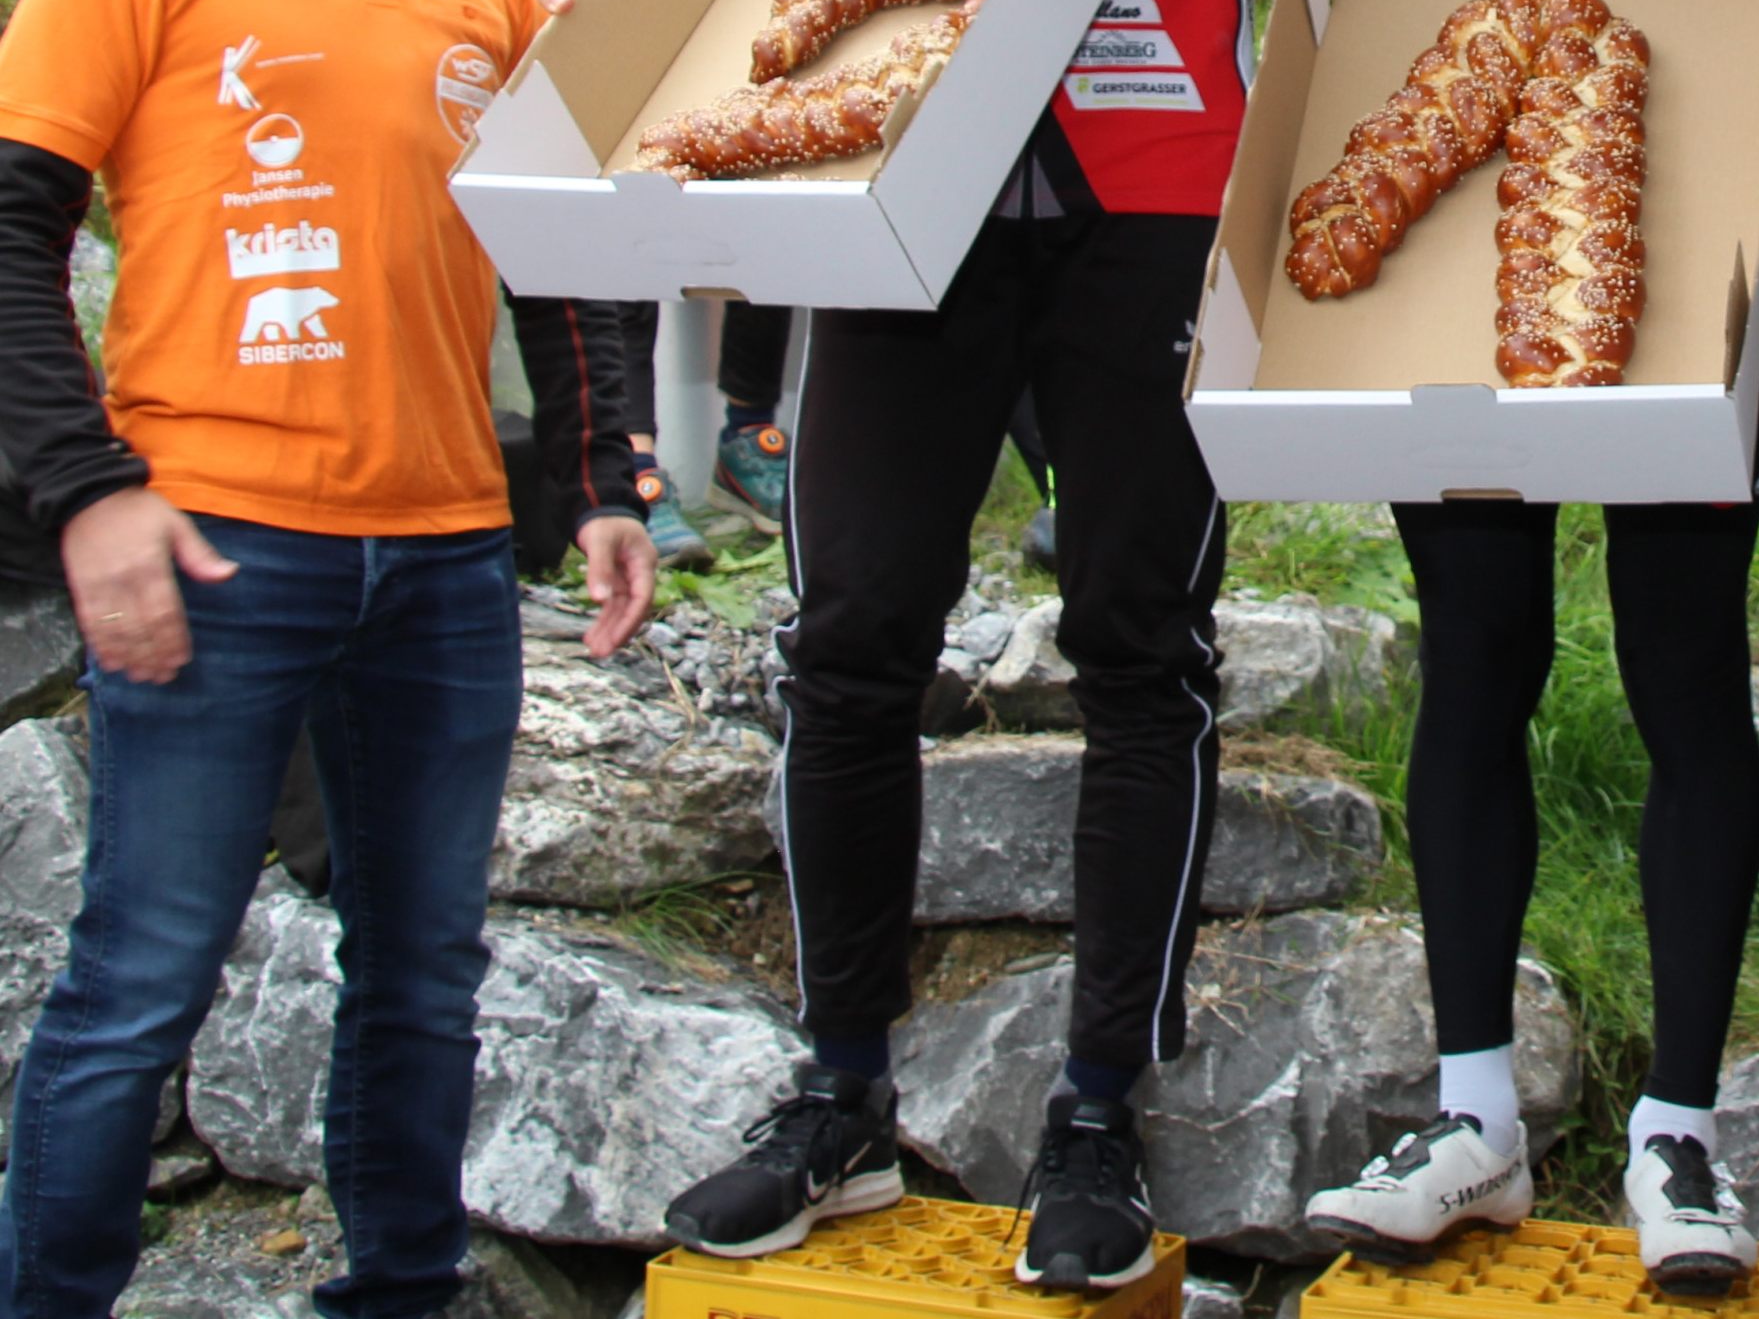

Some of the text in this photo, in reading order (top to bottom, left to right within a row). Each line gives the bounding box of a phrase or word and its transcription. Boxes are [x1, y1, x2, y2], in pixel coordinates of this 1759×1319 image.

[1092, 82, 1187, 94] GERSTGRASSER
[252, 167, 304, 187] Jansen
[222, 182, 336, 209] Physiotherapie
[238, 340, 346, 366] SIBERCON
